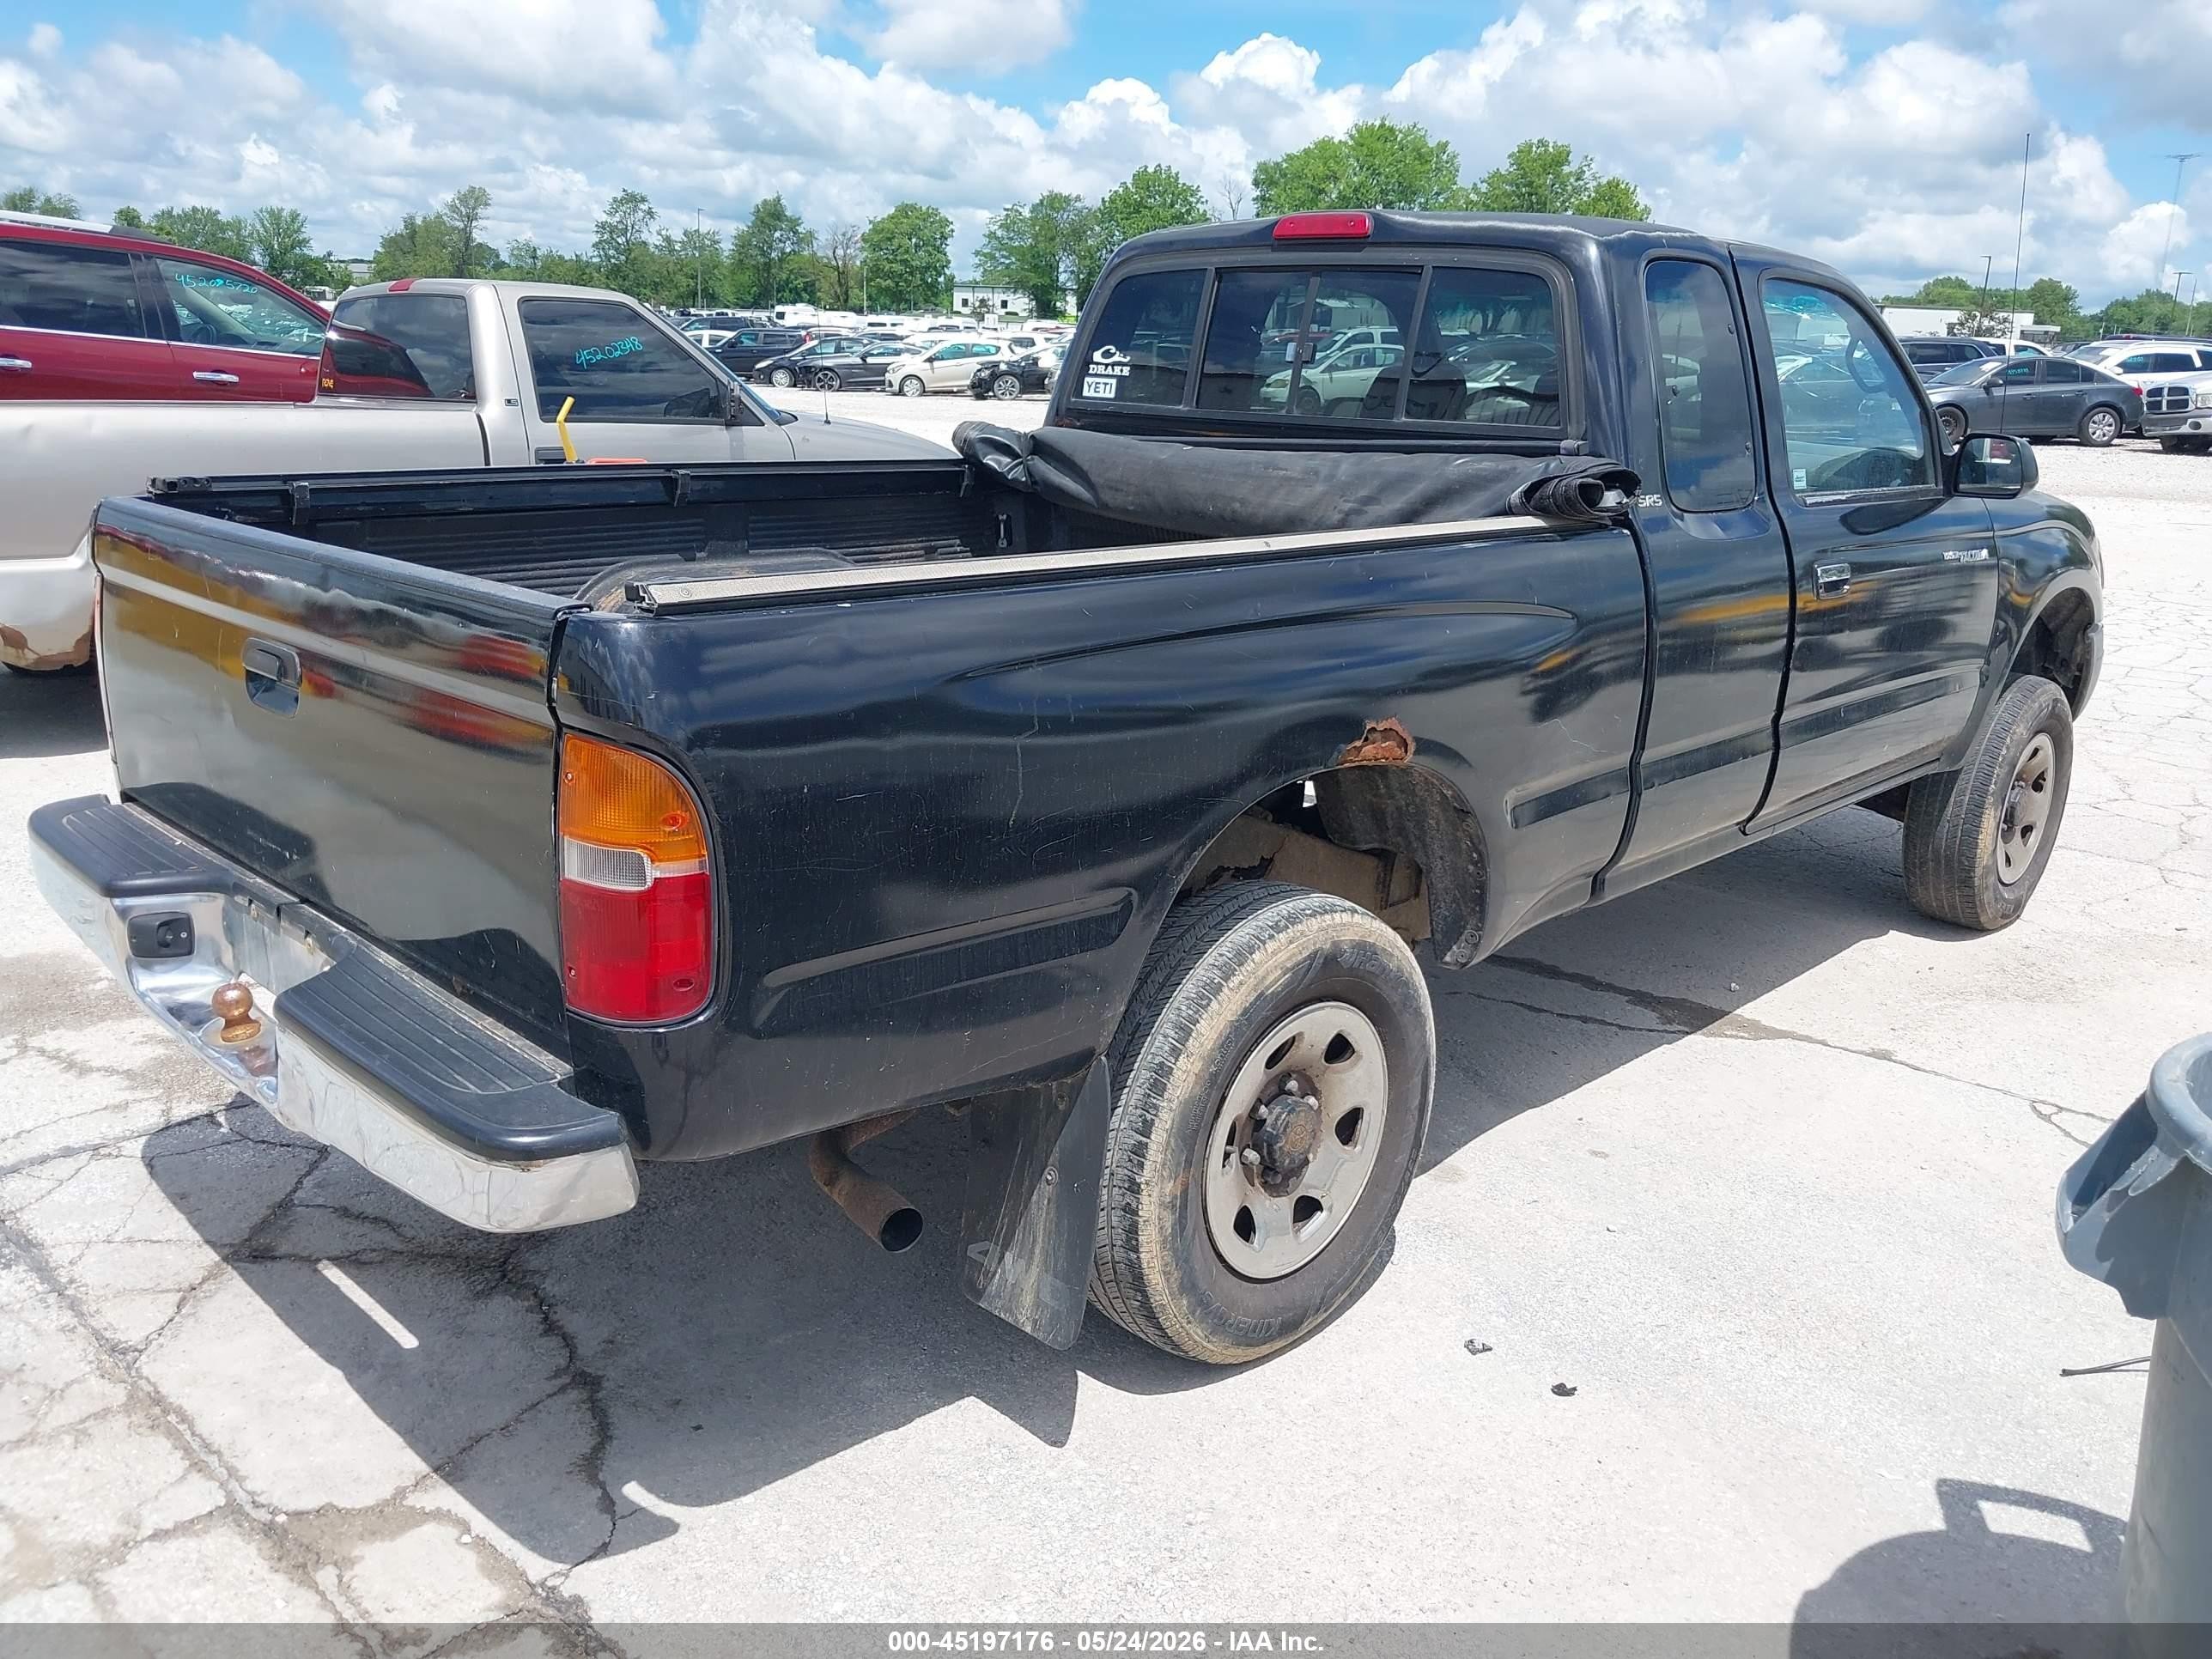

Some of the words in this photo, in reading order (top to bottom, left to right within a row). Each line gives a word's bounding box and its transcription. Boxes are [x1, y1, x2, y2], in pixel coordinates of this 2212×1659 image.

[575, 336, 643, 370] 45202348
[1088, 364, 1131, 376] DRAKE
[1086, 380, 1113, 395] YETI
[1638, 494, 1663, 507] SR5
